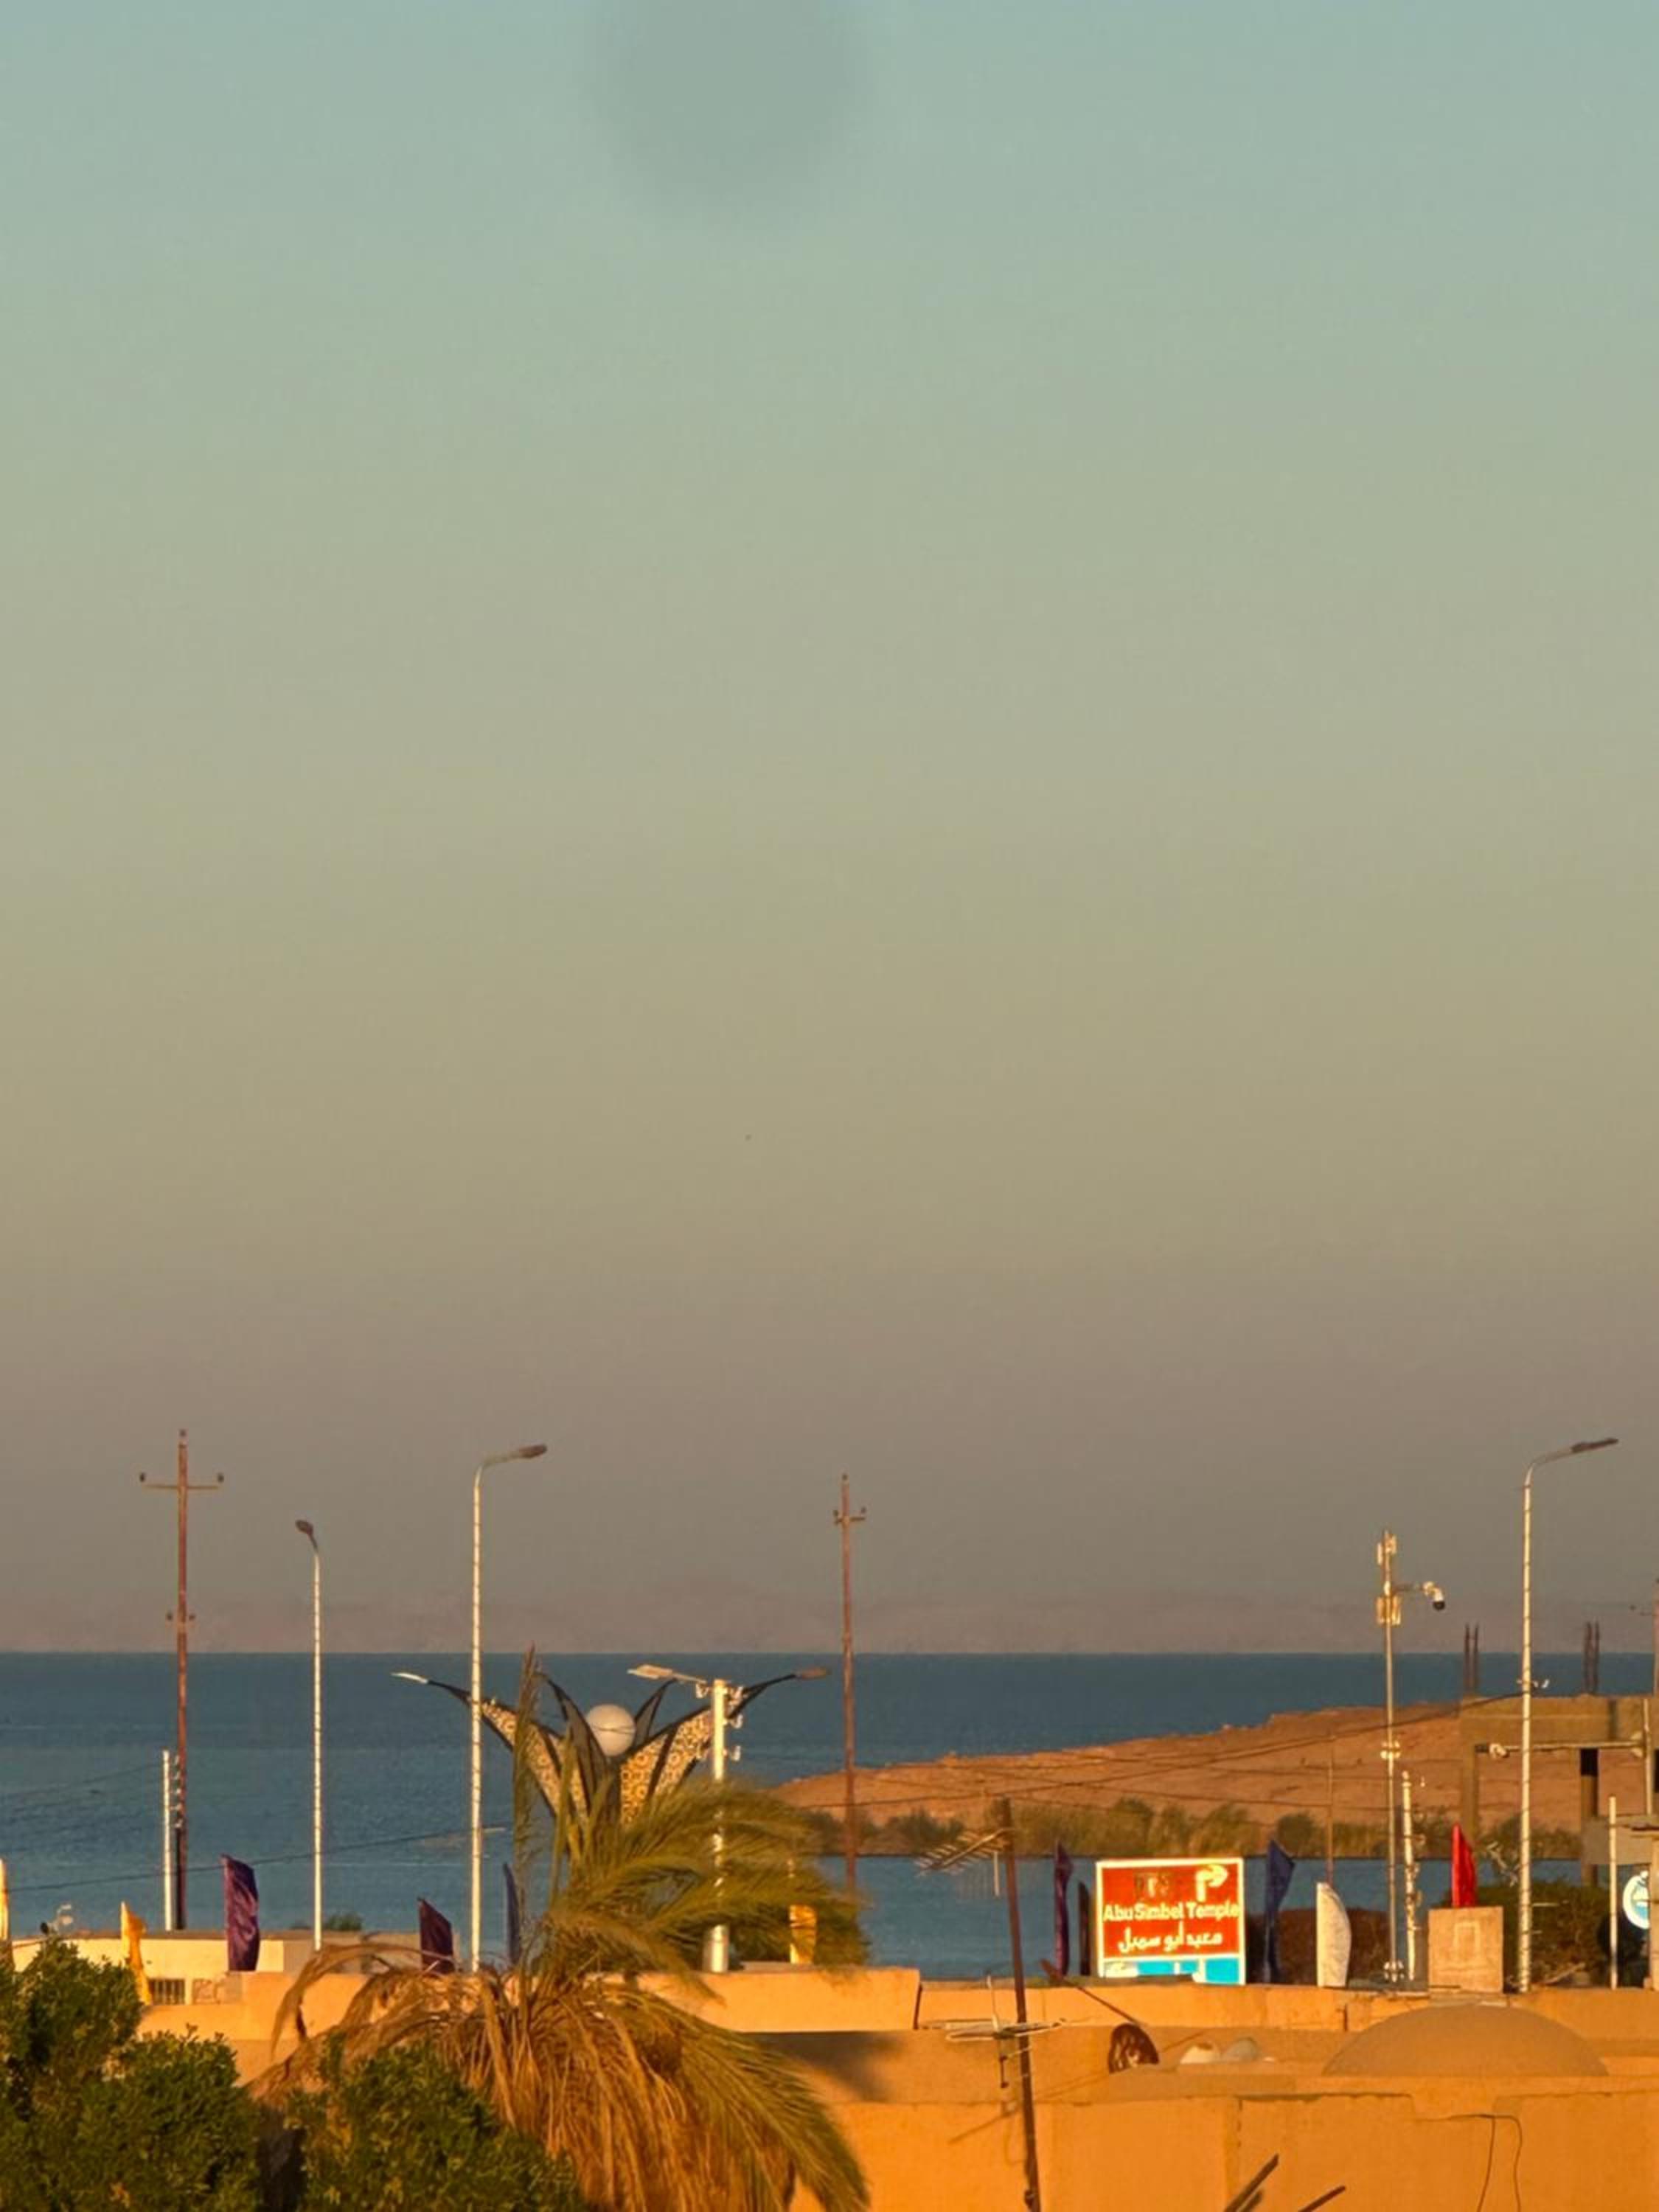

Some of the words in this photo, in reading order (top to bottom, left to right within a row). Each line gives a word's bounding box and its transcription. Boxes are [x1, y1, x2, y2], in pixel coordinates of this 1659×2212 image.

[1104, 1905, 1133, 1921] Abu
[1134, 1902, 1183, 1920] Simbel
[1186, 1900, 1239, 1920] Temple
[1186, 1933, 1222, 1948] معبد
